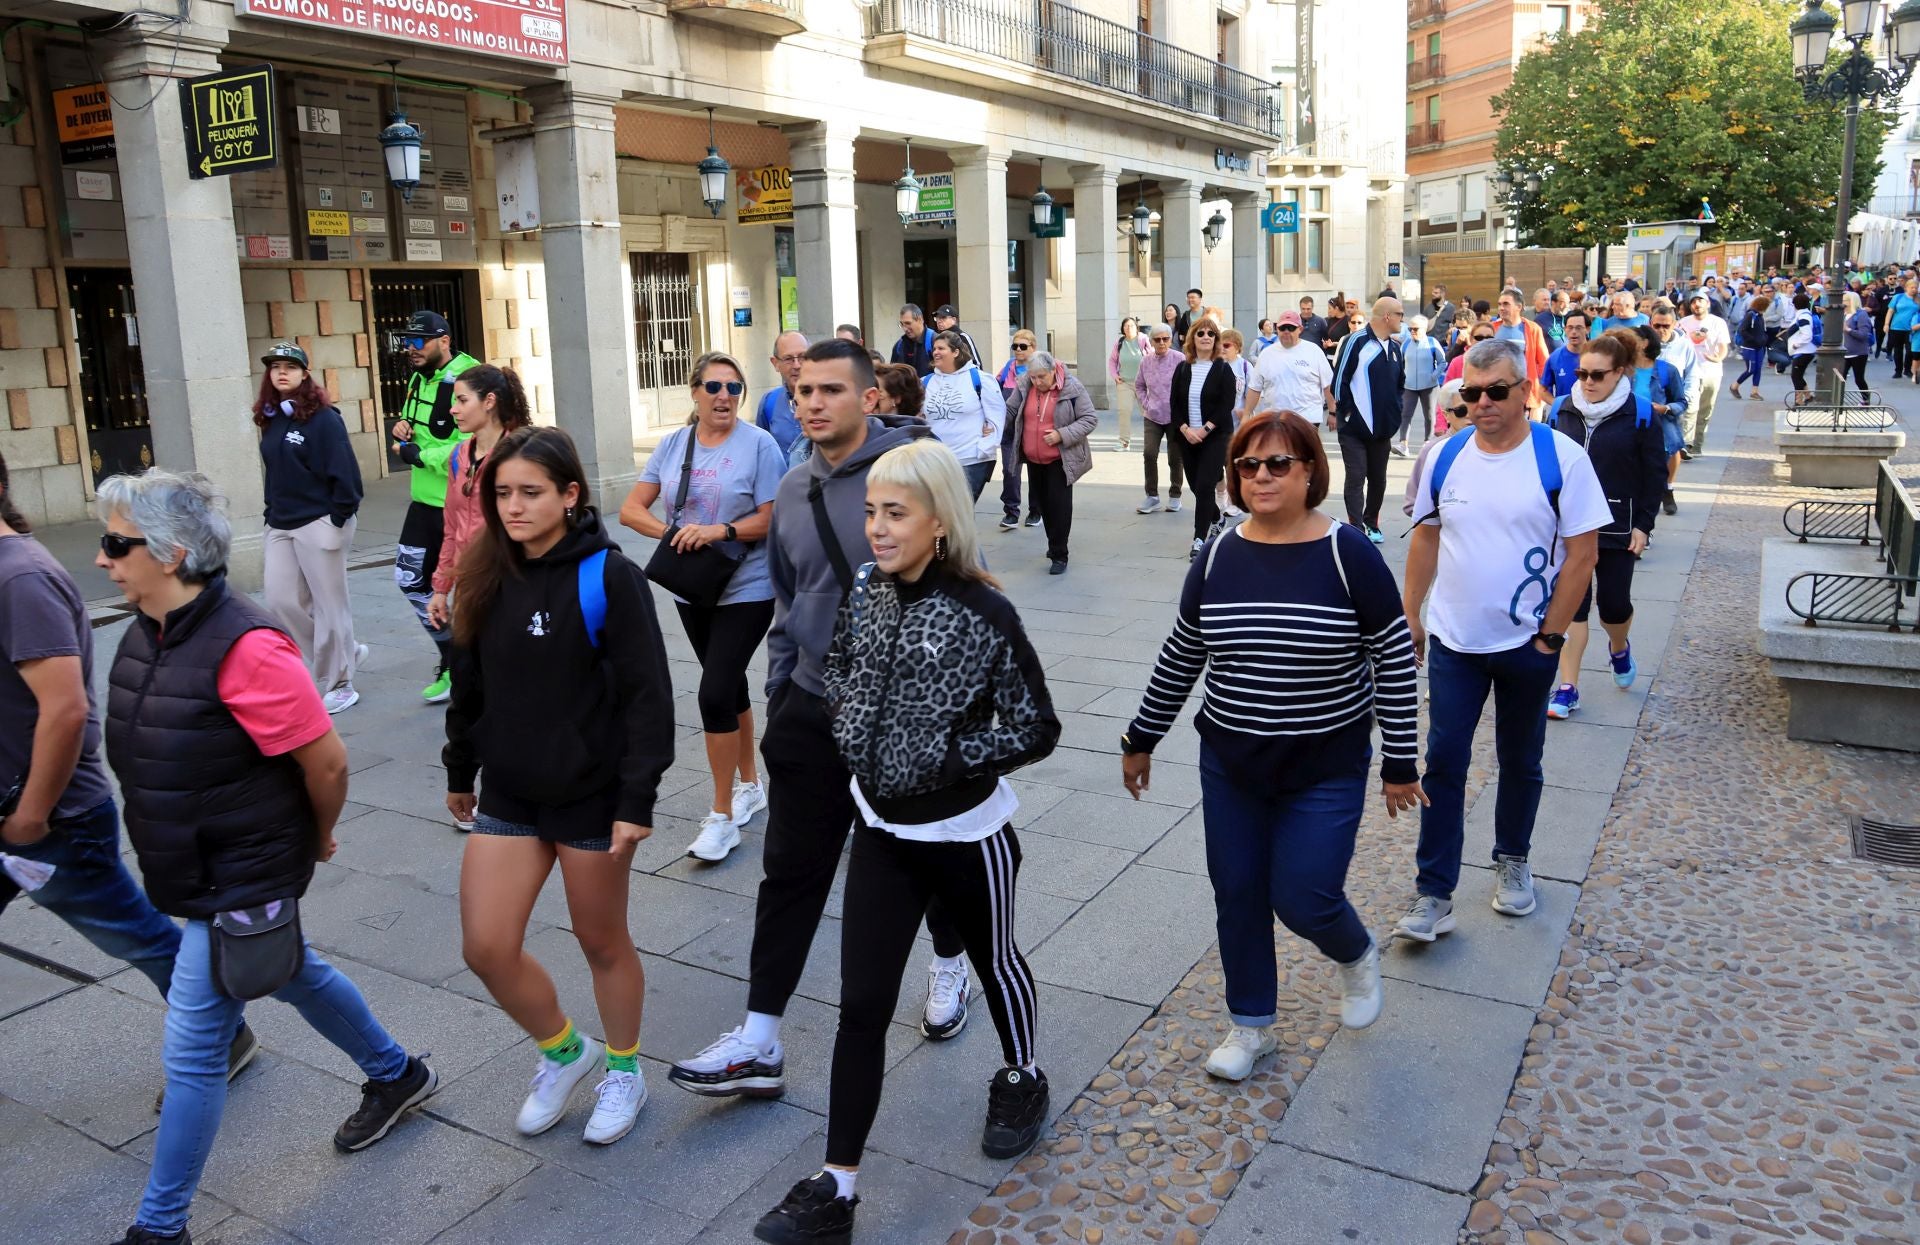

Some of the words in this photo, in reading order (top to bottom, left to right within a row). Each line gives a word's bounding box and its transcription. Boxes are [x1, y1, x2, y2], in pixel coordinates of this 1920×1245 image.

[343, 6, 367, 26] DE
[373, 12, 439, 38] FINCAS
[454, 27, 565, 60] INMOBILIARIA
[534, 28, 559, 38] PLANTA
[1300, 5, 1308, 92] CaixaBank
[73, 92, 107, 108] TALLER
[66, 114, 79, 128] DE
[208, 123, 259, 142] PELUQUERÍA
[214, 140, 253, 159] GOYO
[930, 174, 952, 187] DENTAL
[921, 199, 951, 207] ORTODONCIA
